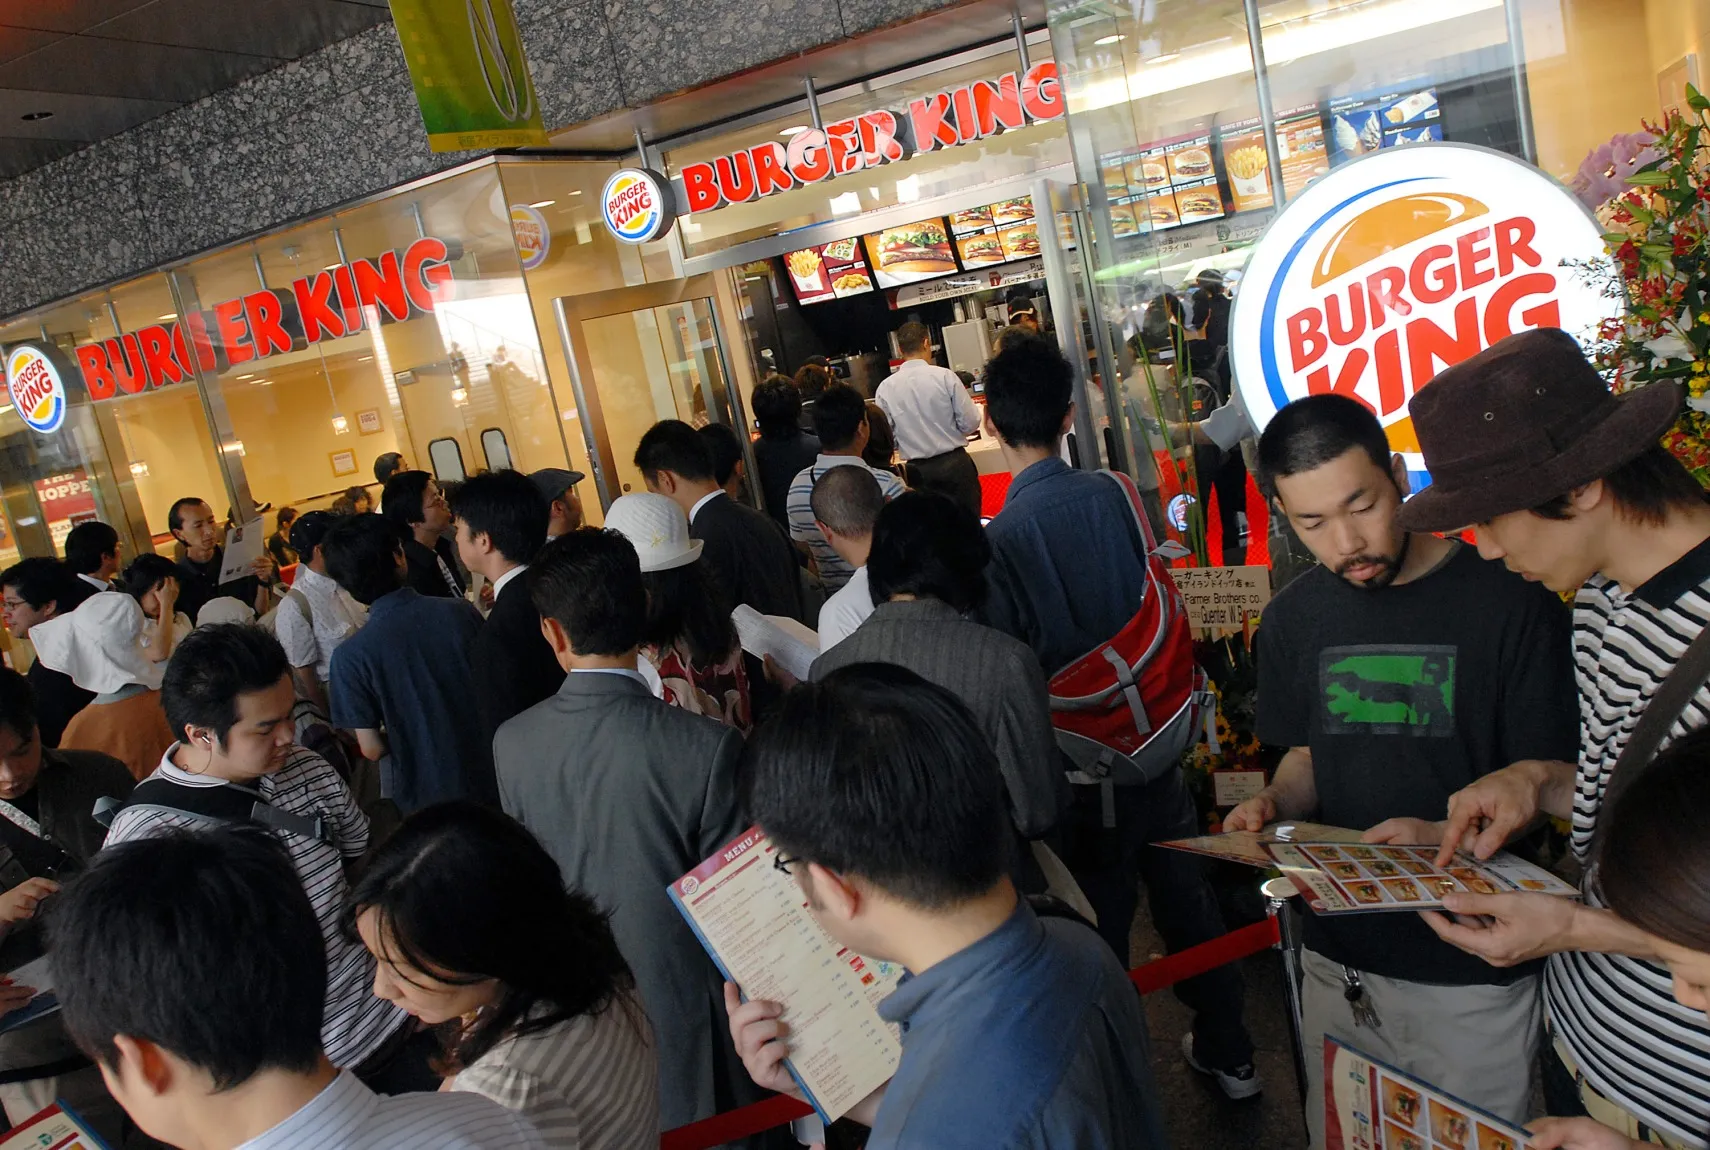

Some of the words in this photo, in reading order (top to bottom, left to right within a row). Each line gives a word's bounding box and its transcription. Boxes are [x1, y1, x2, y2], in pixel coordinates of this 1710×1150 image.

[681, 109, 904, 214] BURGER
[907, 61, 1068, 154] KING
[608, 181, 647, 214] BURGER
[614, 191, 652, 231] KING
[1286, 216, 1542, 374] BURGER
[74, 289, 293, 401] BURGER
[293, 237, 458, 345] KING
[1306, 272, 1561, 417] KING
[12, 358, 46, 399] BURGER
[19, 372, 54, 419] KING
[1184, 593, 1211, 604] Farmer
[1213, 593, 1247, 604] Brothers
[1249, 594, 1262, 604] co.
[1200, 604, 1227, 625] Guenter
[723, 836, 754, 862] MENU
